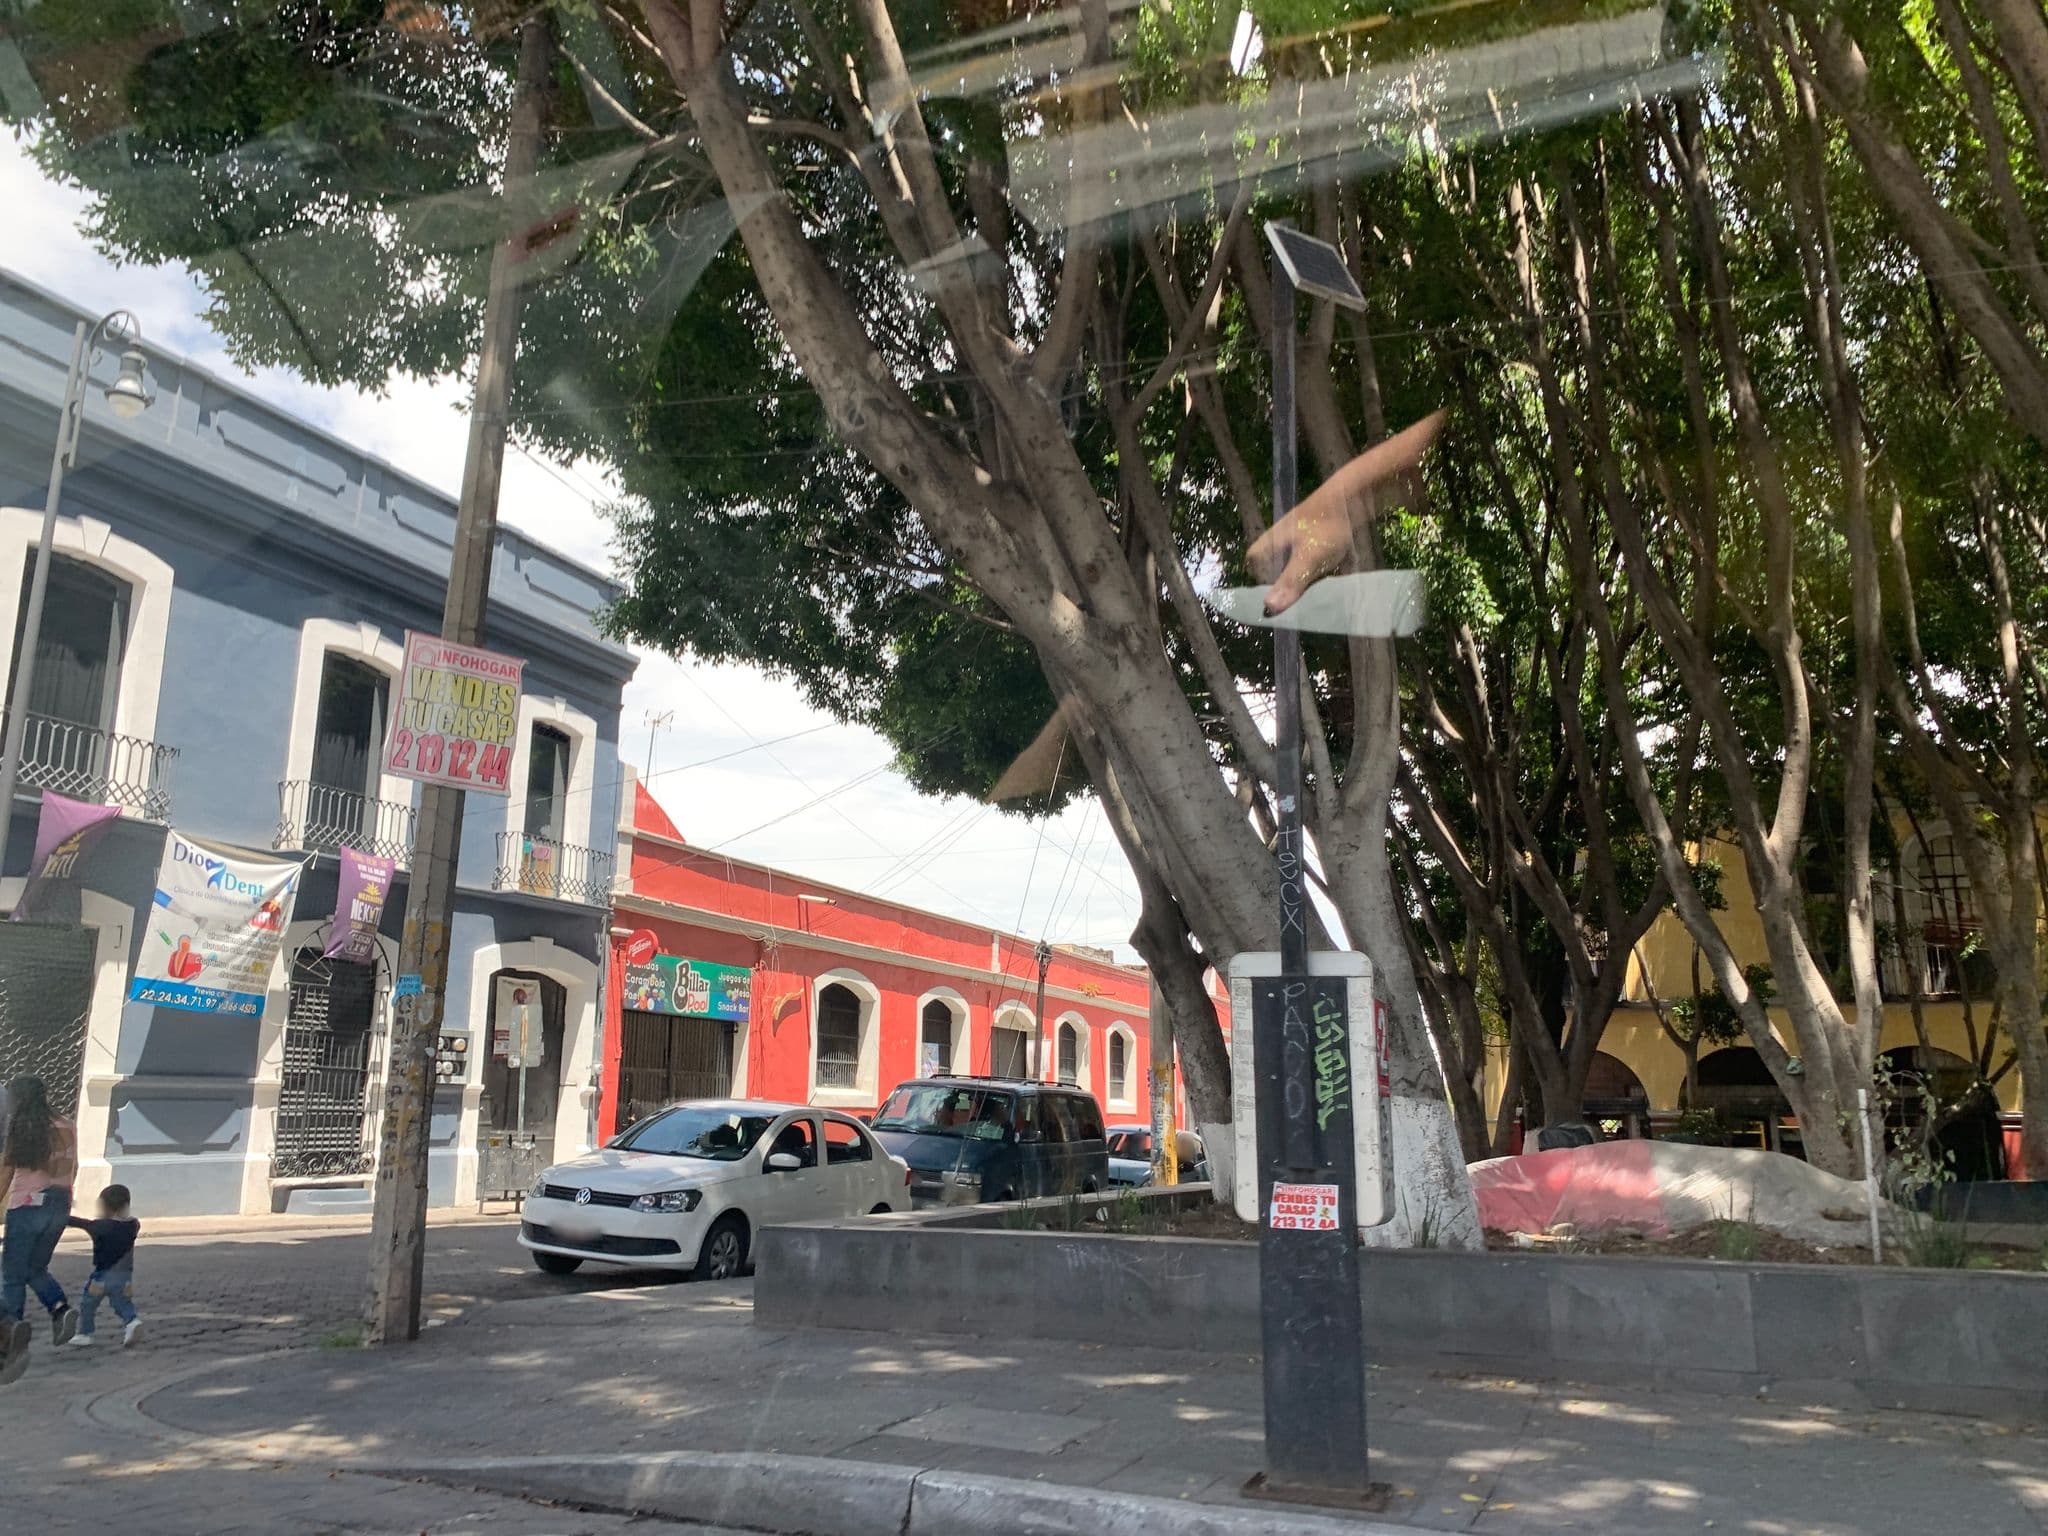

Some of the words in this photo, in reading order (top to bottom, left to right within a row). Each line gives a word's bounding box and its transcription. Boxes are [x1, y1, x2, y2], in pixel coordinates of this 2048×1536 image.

[438, 650, 518, 679] INFOHOGAR
[411, 665, 517, 716] VENDES
[402, 698, 434, 732] TU
[436, 705, 515, 745] CASA?
[173, 842, 204, 867] Dio
[224, 872, 265, 897] Dent
[625, 973, 666, 988] Carambola
[676, 961, 709, 1000] Billar
[719, 972, 741, 984] Juegos
[688, 992, 708, 1012] Pool
[718, 1001, 737, 1012] Snack
[1274, 1193, 1317, 1205] VENDES
[1320, 1196, 1336, 1206] TU
[1278, 1204, 1316, 1215] CASA?
[1273, 1216, 1296, 1228] 213
[1300, 1217, 1315, 1228] 12
[1319, 1219, 1335, 1229] 44
